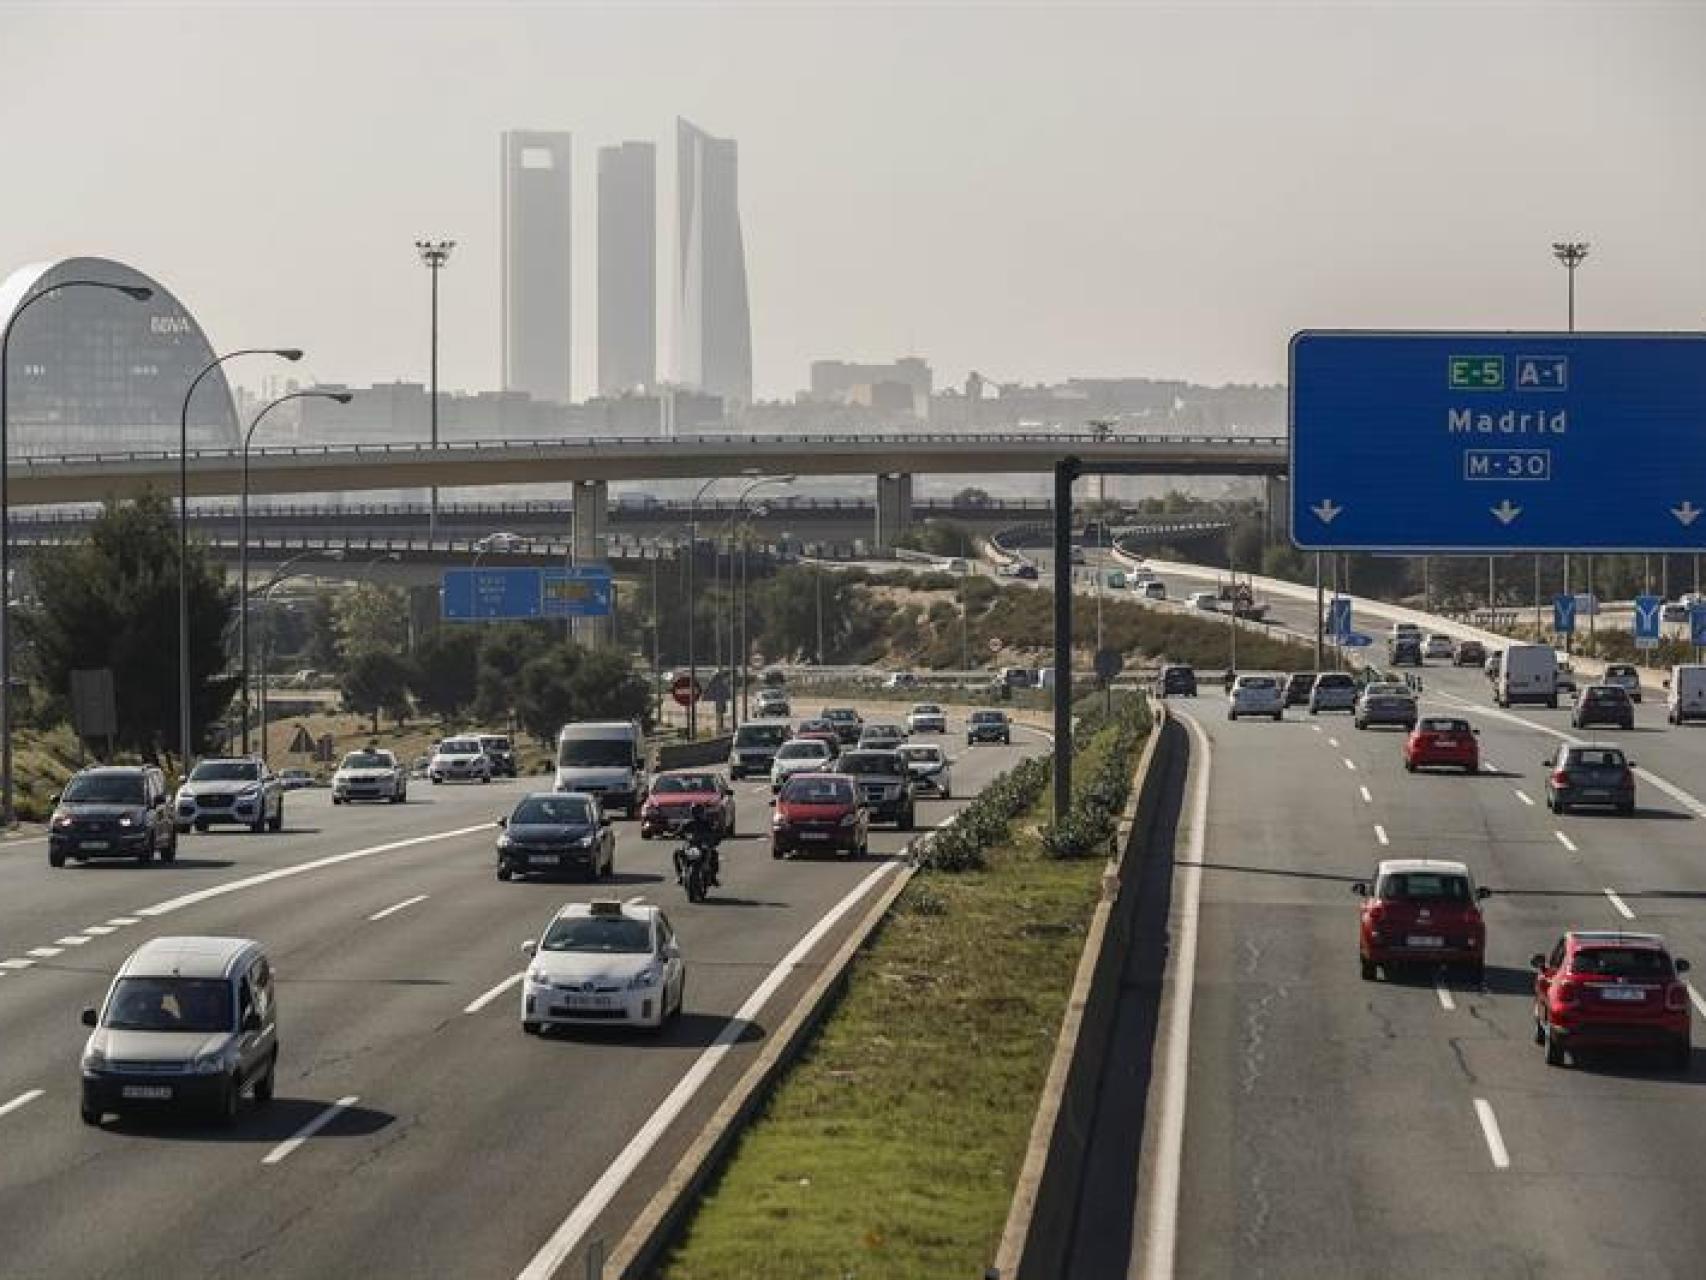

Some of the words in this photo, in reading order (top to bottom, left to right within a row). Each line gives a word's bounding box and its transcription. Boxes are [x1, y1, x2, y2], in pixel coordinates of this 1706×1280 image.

[1452, 361, 1500, 385] E-5
[1520, 362, 1565, 385] A-1
[1448, 408, 1566, 433] Madrid
[1469, 456, 1545, 475] M-30
